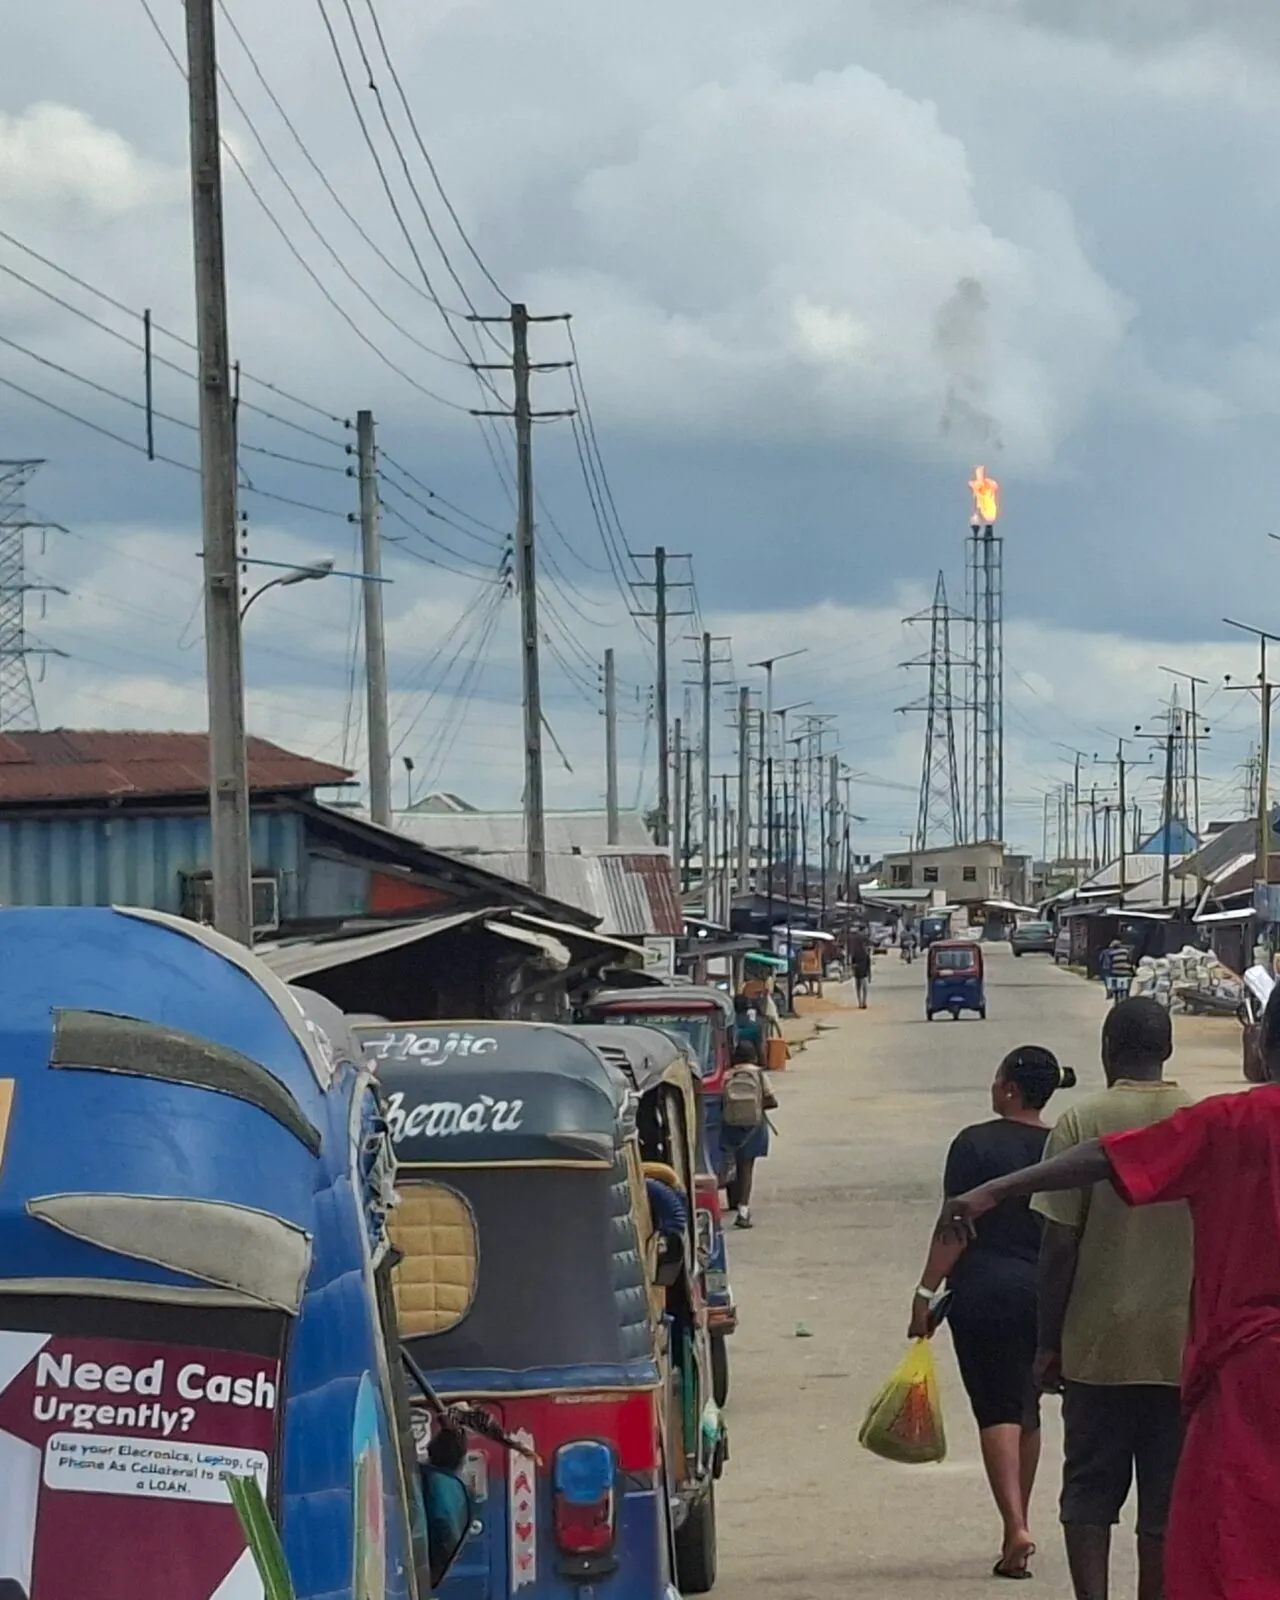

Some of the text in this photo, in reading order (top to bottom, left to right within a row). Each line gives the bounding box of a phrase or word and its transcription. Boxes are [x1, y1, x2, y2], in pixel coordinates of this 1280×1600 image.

[36, 1352, 276, 1409] Need Cash
[33, 1395, 196, 1436] Urgently?
[50, 1440, 77, 1453] Use
[81, 1444, 116, 1457] your
[107, 1460, 127, 1472] As
[201, 1469, 214, 1480] to
[136, 1479, 191, 1493] a LOAN.
